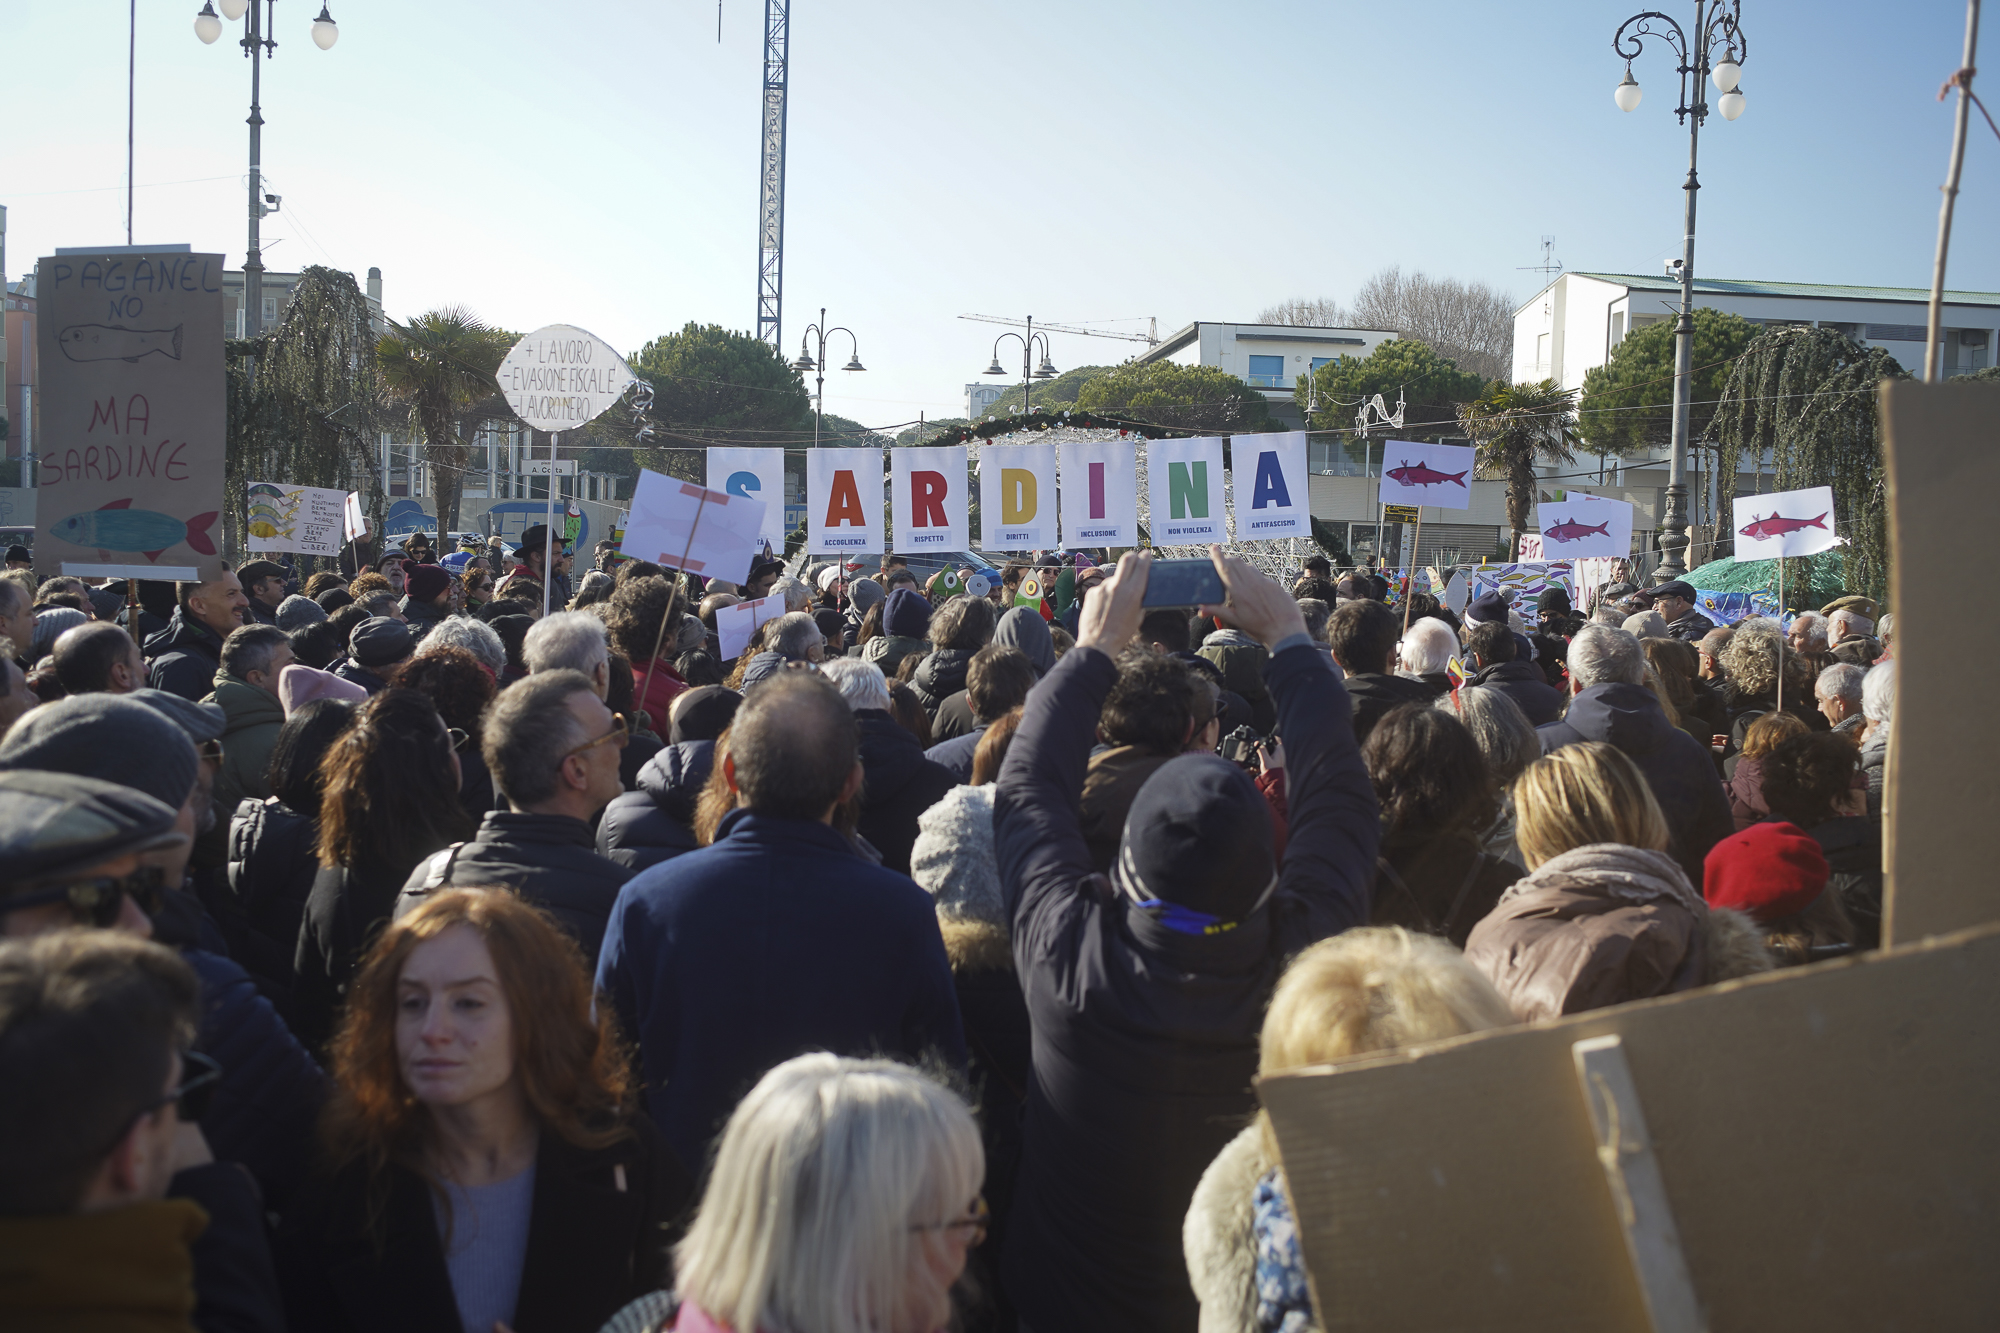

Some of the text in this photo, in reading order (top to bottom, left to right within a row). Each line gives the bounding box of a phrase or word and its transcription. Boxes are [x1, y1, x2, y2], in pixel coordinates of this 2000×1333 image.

[108, 297, 144, 321] NO
[540, 340, 592, 364] LAVORO
[513, 366, 568, 392] EVASIONE
[570, 366, 616, 394] FISCALE
[88, 394, 149, 435] MA
[519, 396, 561, 419] LAVORO
[41, 440, 190, 486] SARDINE
[825, 470, 866, 527] A
[910, 470, 950, 528] R
[1001, 468, 1038, 525] D
[1088, 462, 1106, 519] I
[1168, 461, 1209, 520] N
[1252, 451, 1293, 510] A
[1080, 529, 1117, 538] INCLUSIONE
[1182, 526, 1213, 534] VIOLENZA
[1251, 520, 1296, 530] ANTIFASCISMO
[824, 538, 866, 546] ACCOGLIENZA
[914, 535, 944, 543] RISPETTO
